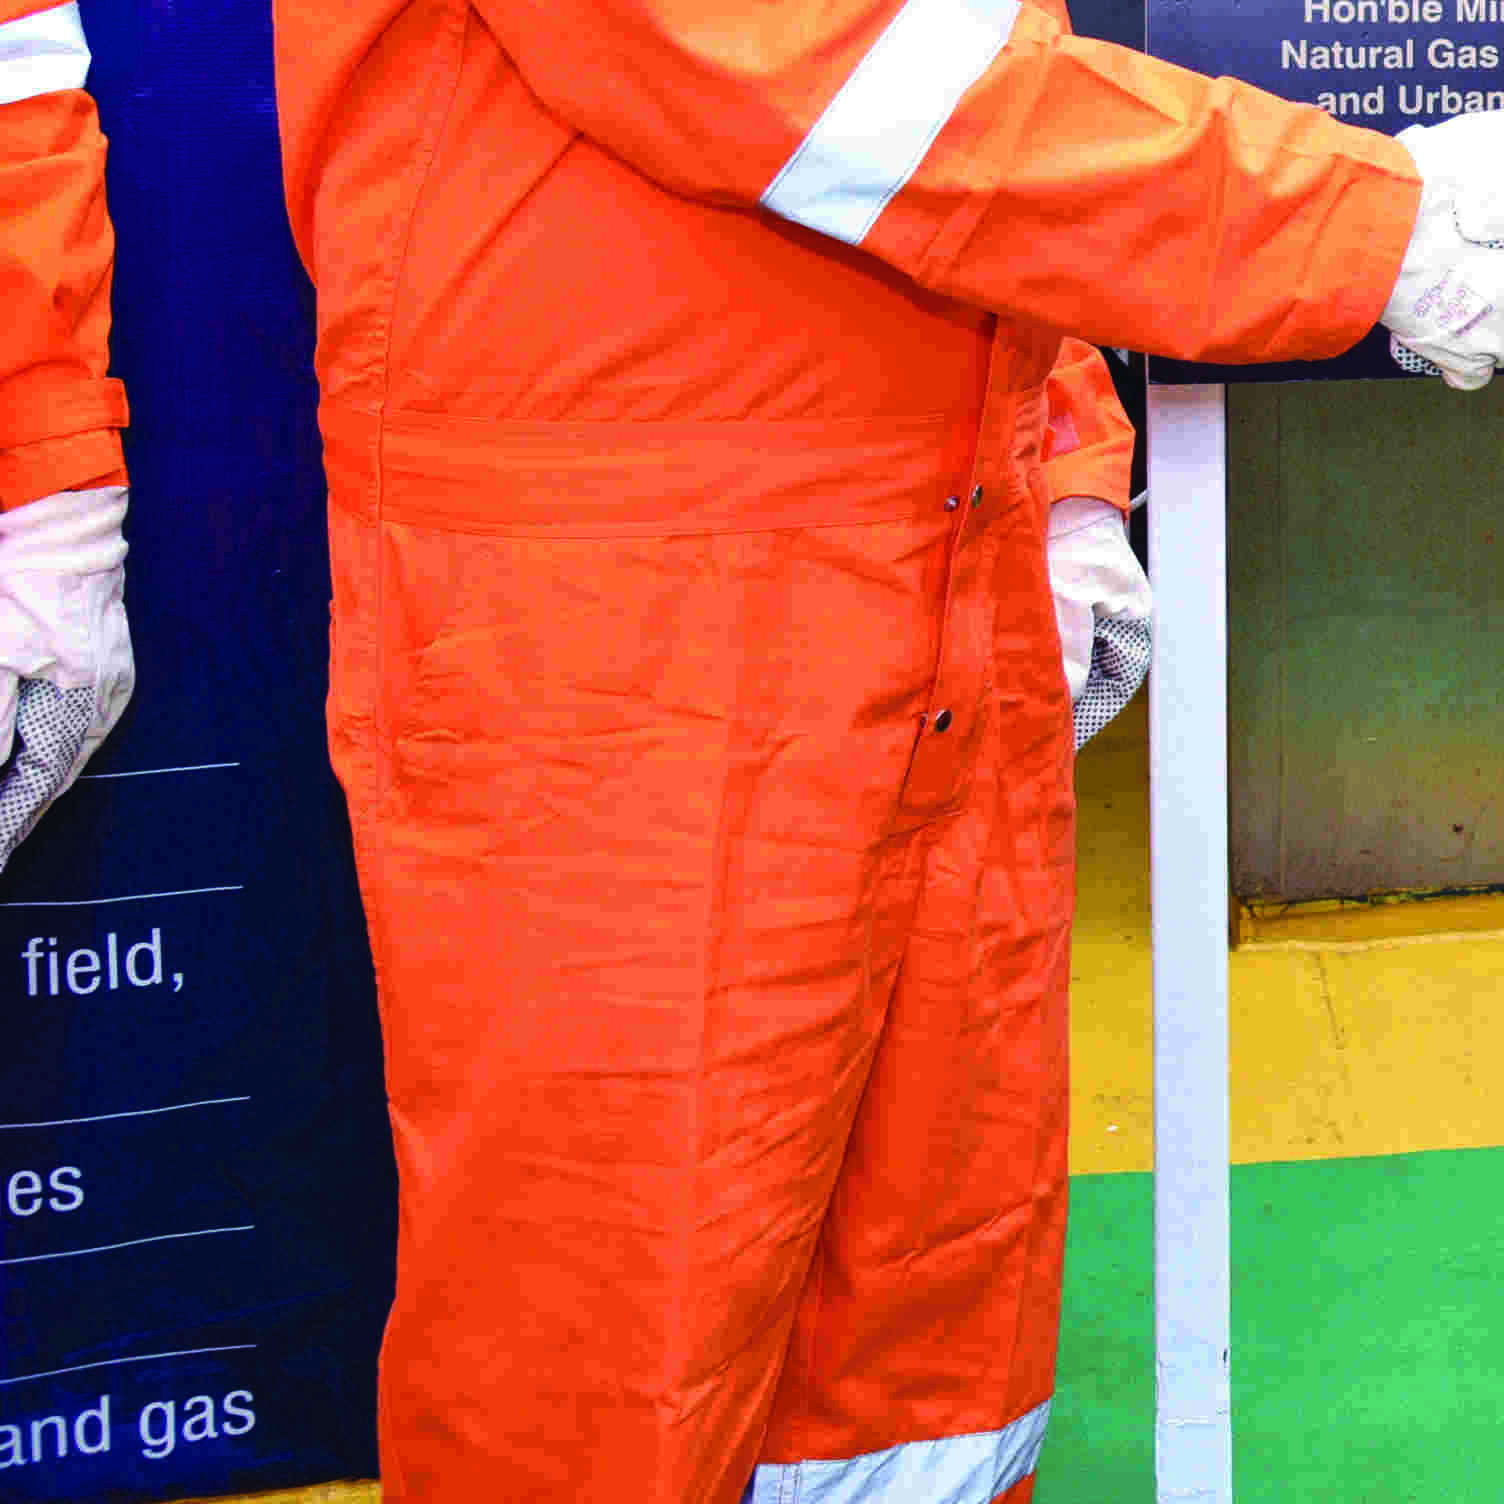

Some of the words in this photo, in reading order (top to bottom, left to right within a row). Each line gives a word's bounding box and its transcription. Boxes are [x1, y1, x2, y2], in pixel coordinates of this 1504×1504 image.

[1281, 39, 1414, 70] Natural
[1427, 38, 1499, 69] Gas
[1316, 84, 1385, 115] and
[21, 927, 183, 996] field,
[0, 1395, 111, 1469] and
[139, 1390, 256, 1459] gas
